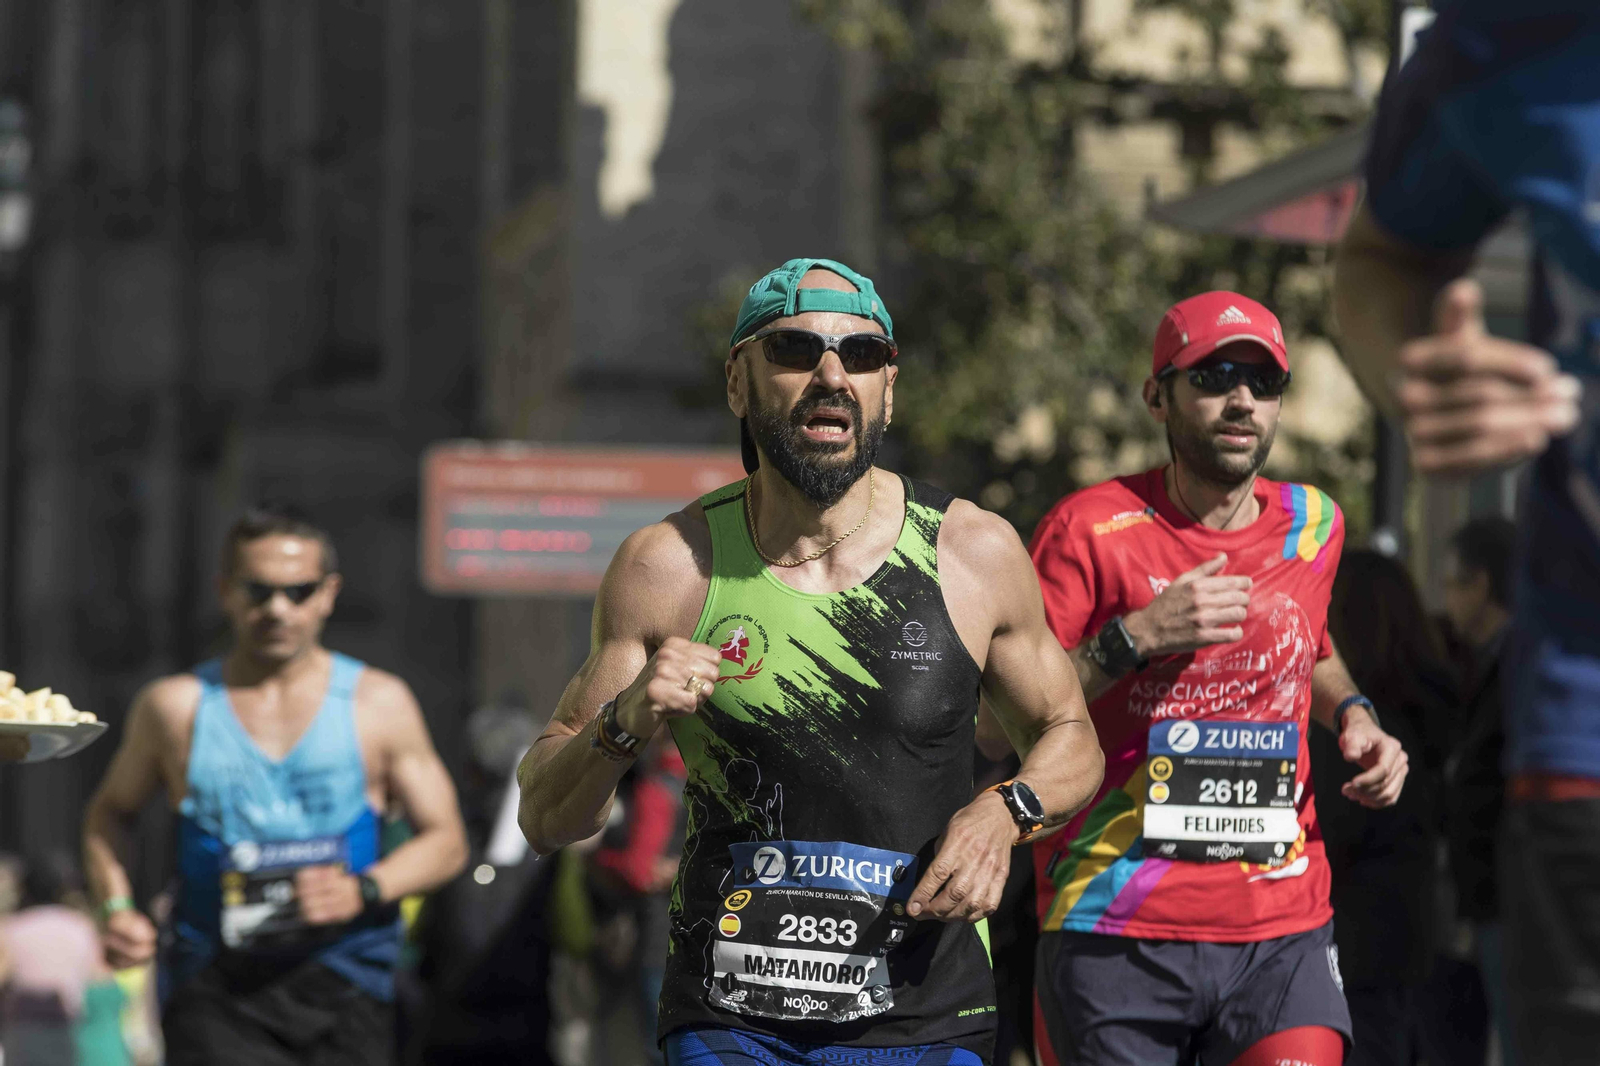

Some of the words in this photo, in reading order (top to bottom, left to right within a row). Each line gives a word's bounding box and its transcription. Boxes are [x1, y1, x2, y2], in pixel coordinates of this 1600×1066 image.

[705, 613, 741, 646] ratonianos
[743, 614, 753, 622] de
[753, 619, 770, 654] Leganés
[890, 650, 943, 661] ZYMETRIC
[1130, 679, 1257, 700] ASOCIACIÓN
[1127, 700, 1196, 719] MARCO
[1204, 728, 1285, 750] ZURICH
[1198, 777, 1258, 804] 2612
[1184, 815, 1265, 834] FELIPIDES
[791, 855, 892, 887] ZURICH
[786, 890, 814, 898] MARATÓN
[825, 892, 849, 901] SEVILLA
[777, 913, 858, 947] 2833
